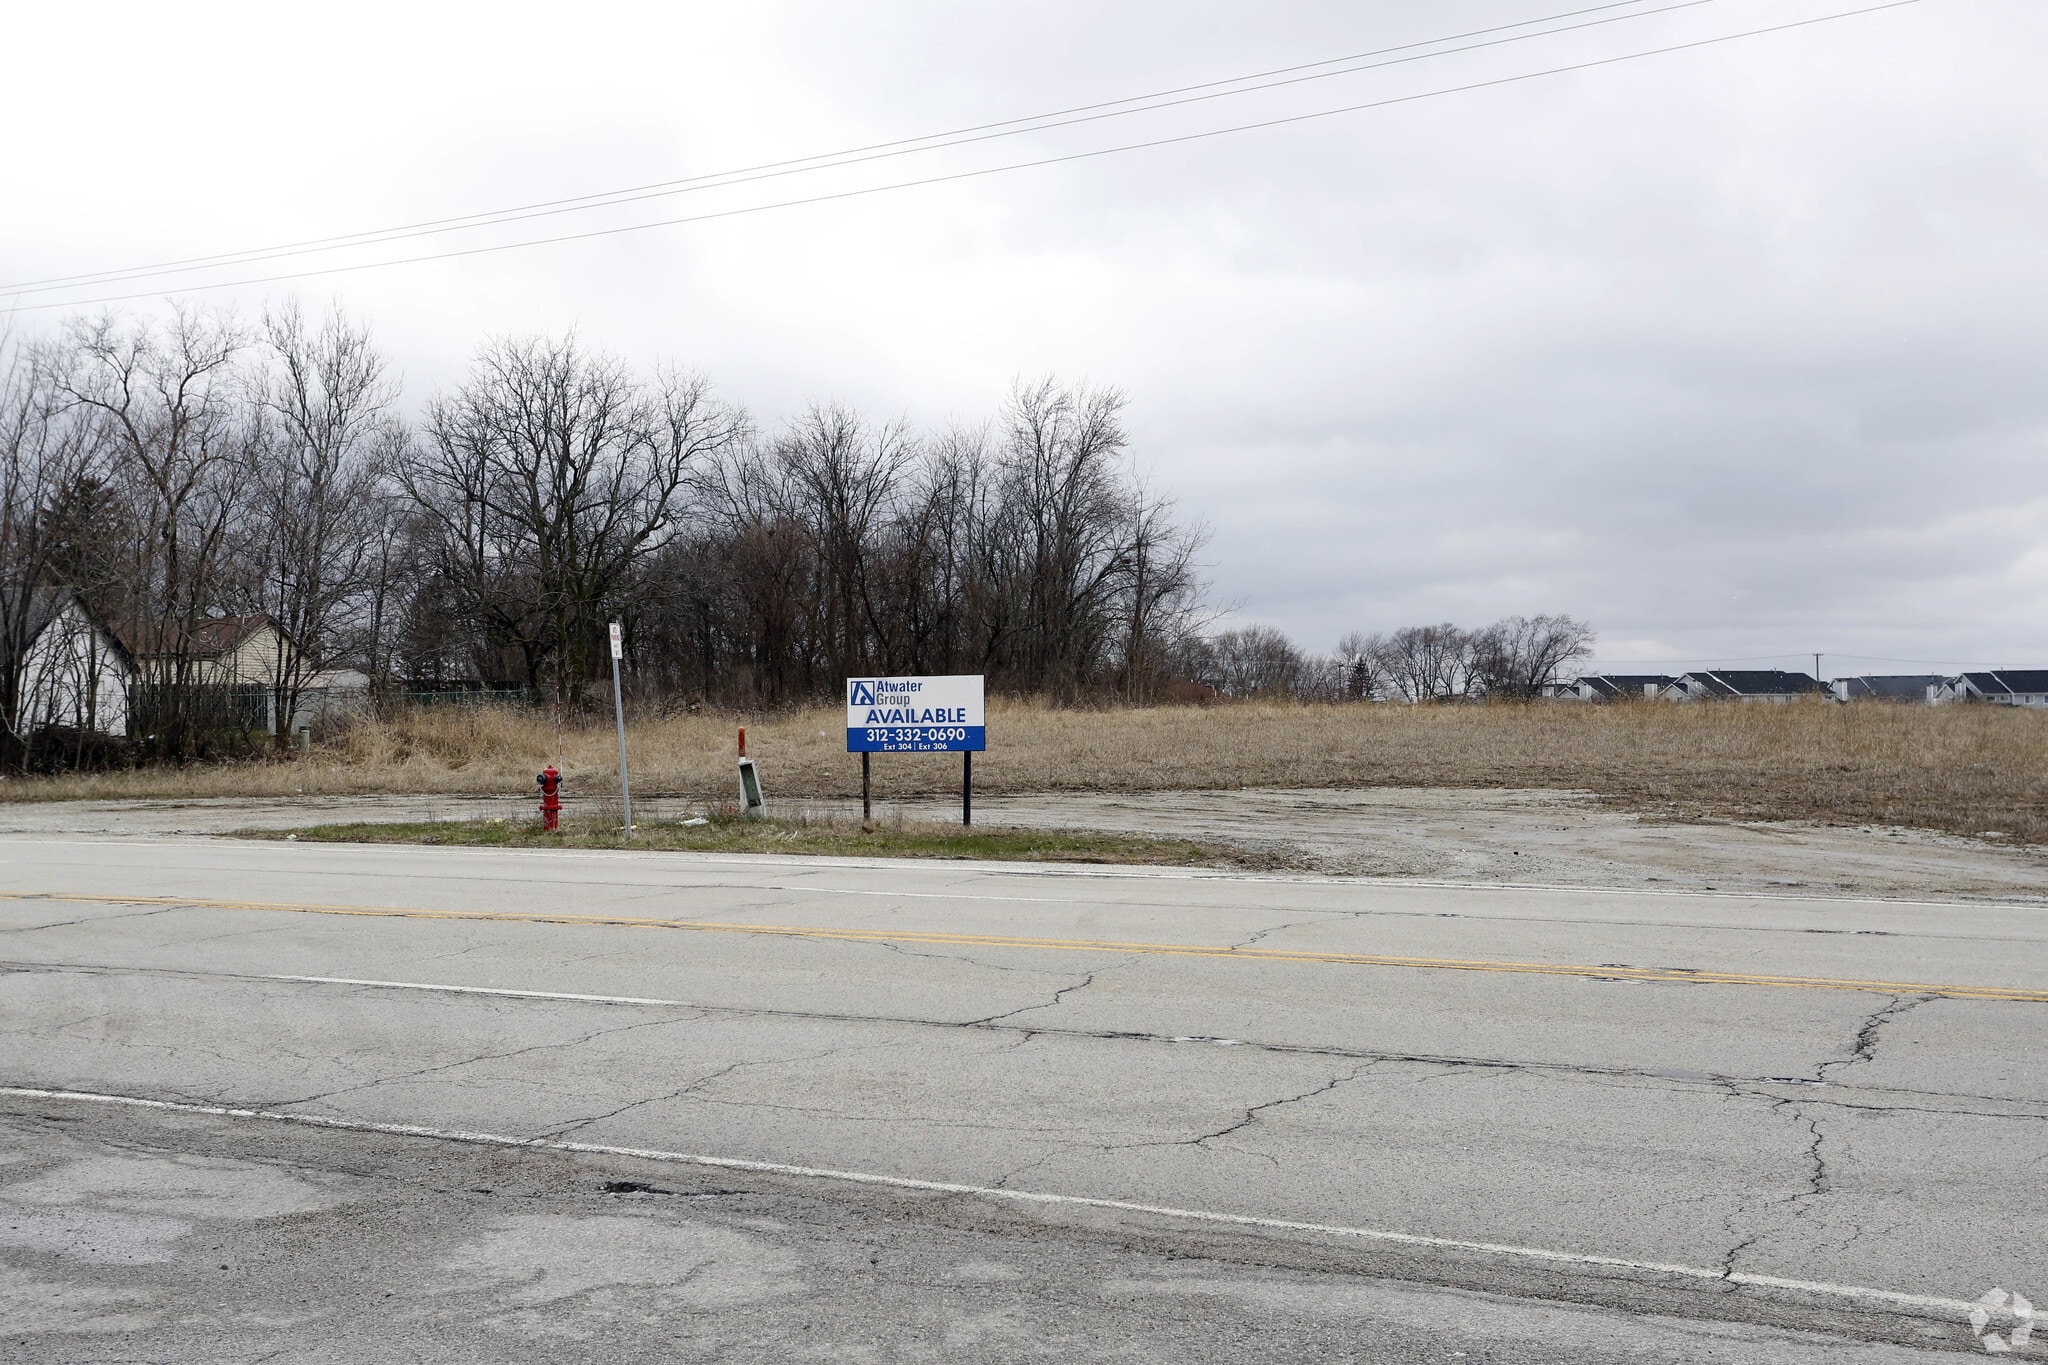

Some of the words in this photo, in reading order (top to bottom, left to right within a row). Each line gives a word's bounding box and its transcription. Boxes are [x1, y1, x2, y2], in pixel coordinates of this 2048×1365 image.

[877, 681, 922, 692] Atwater
[877, 693, 910, 707] Group
[866, 708, 966, 724] AVAILABLE
[867, 728, 966, 742] 312-332-0690
[933, 742, 947, 750] 306
